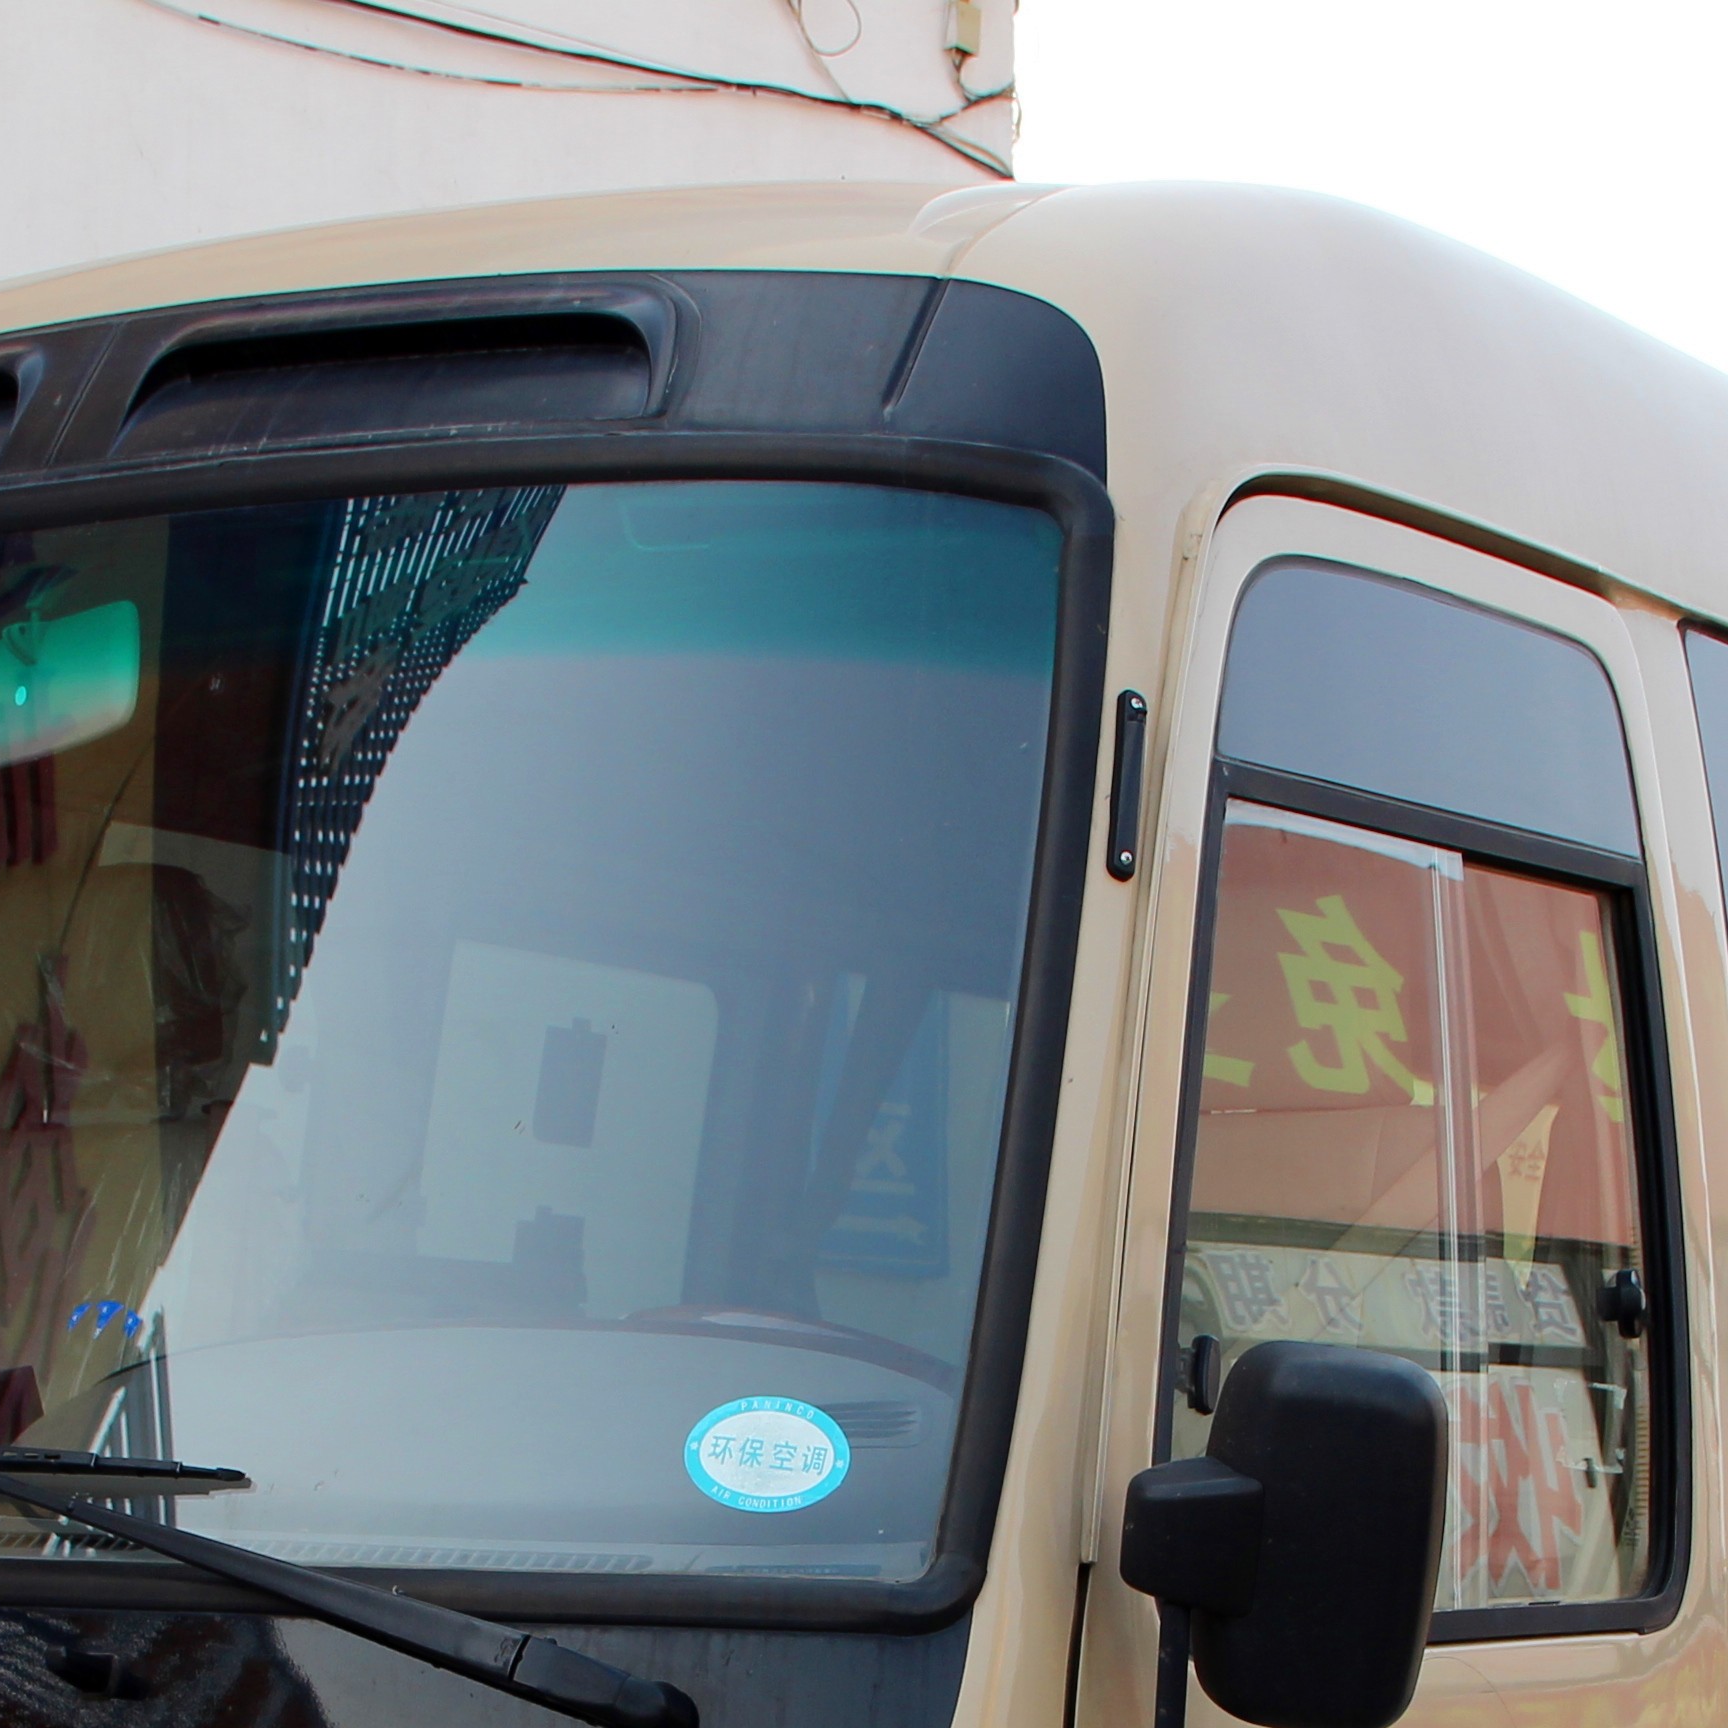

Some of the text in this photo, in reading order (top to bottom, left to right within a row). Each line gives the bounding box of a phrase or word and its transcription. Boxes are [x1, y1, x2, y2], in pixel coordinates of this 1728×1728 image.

[708, 1434, 829, 1476] 环保空调
[710, 1486, 803, 1508] AIR CONDITION
